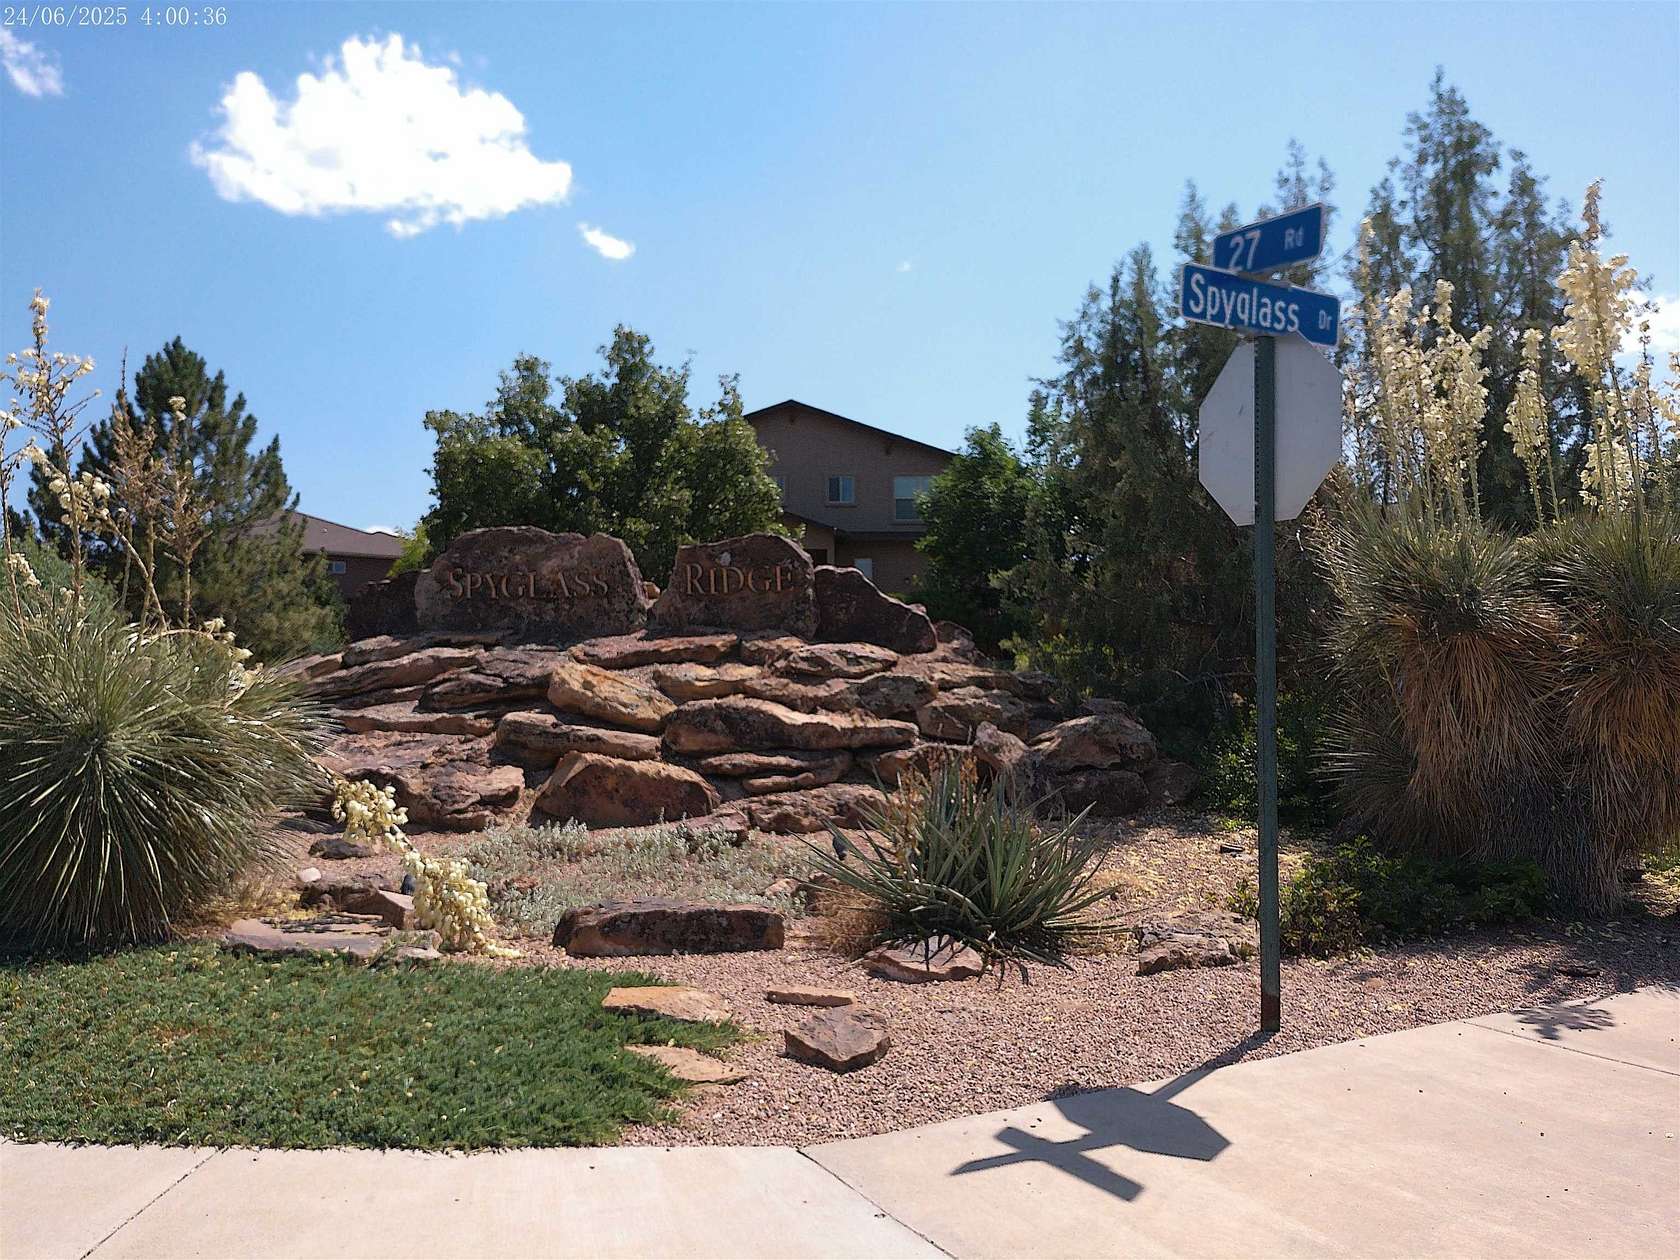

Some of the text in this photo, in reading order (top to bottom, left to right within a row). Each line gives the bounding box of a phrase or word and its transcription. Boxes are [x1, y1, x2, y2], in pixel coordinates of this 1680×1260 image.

[1229, 226, 1304, 271] 27 Rd
[1189, 272, 1333, 332] Spyglass Dr
[448, 563, 796, 600] SPYGLASS RIDGE
